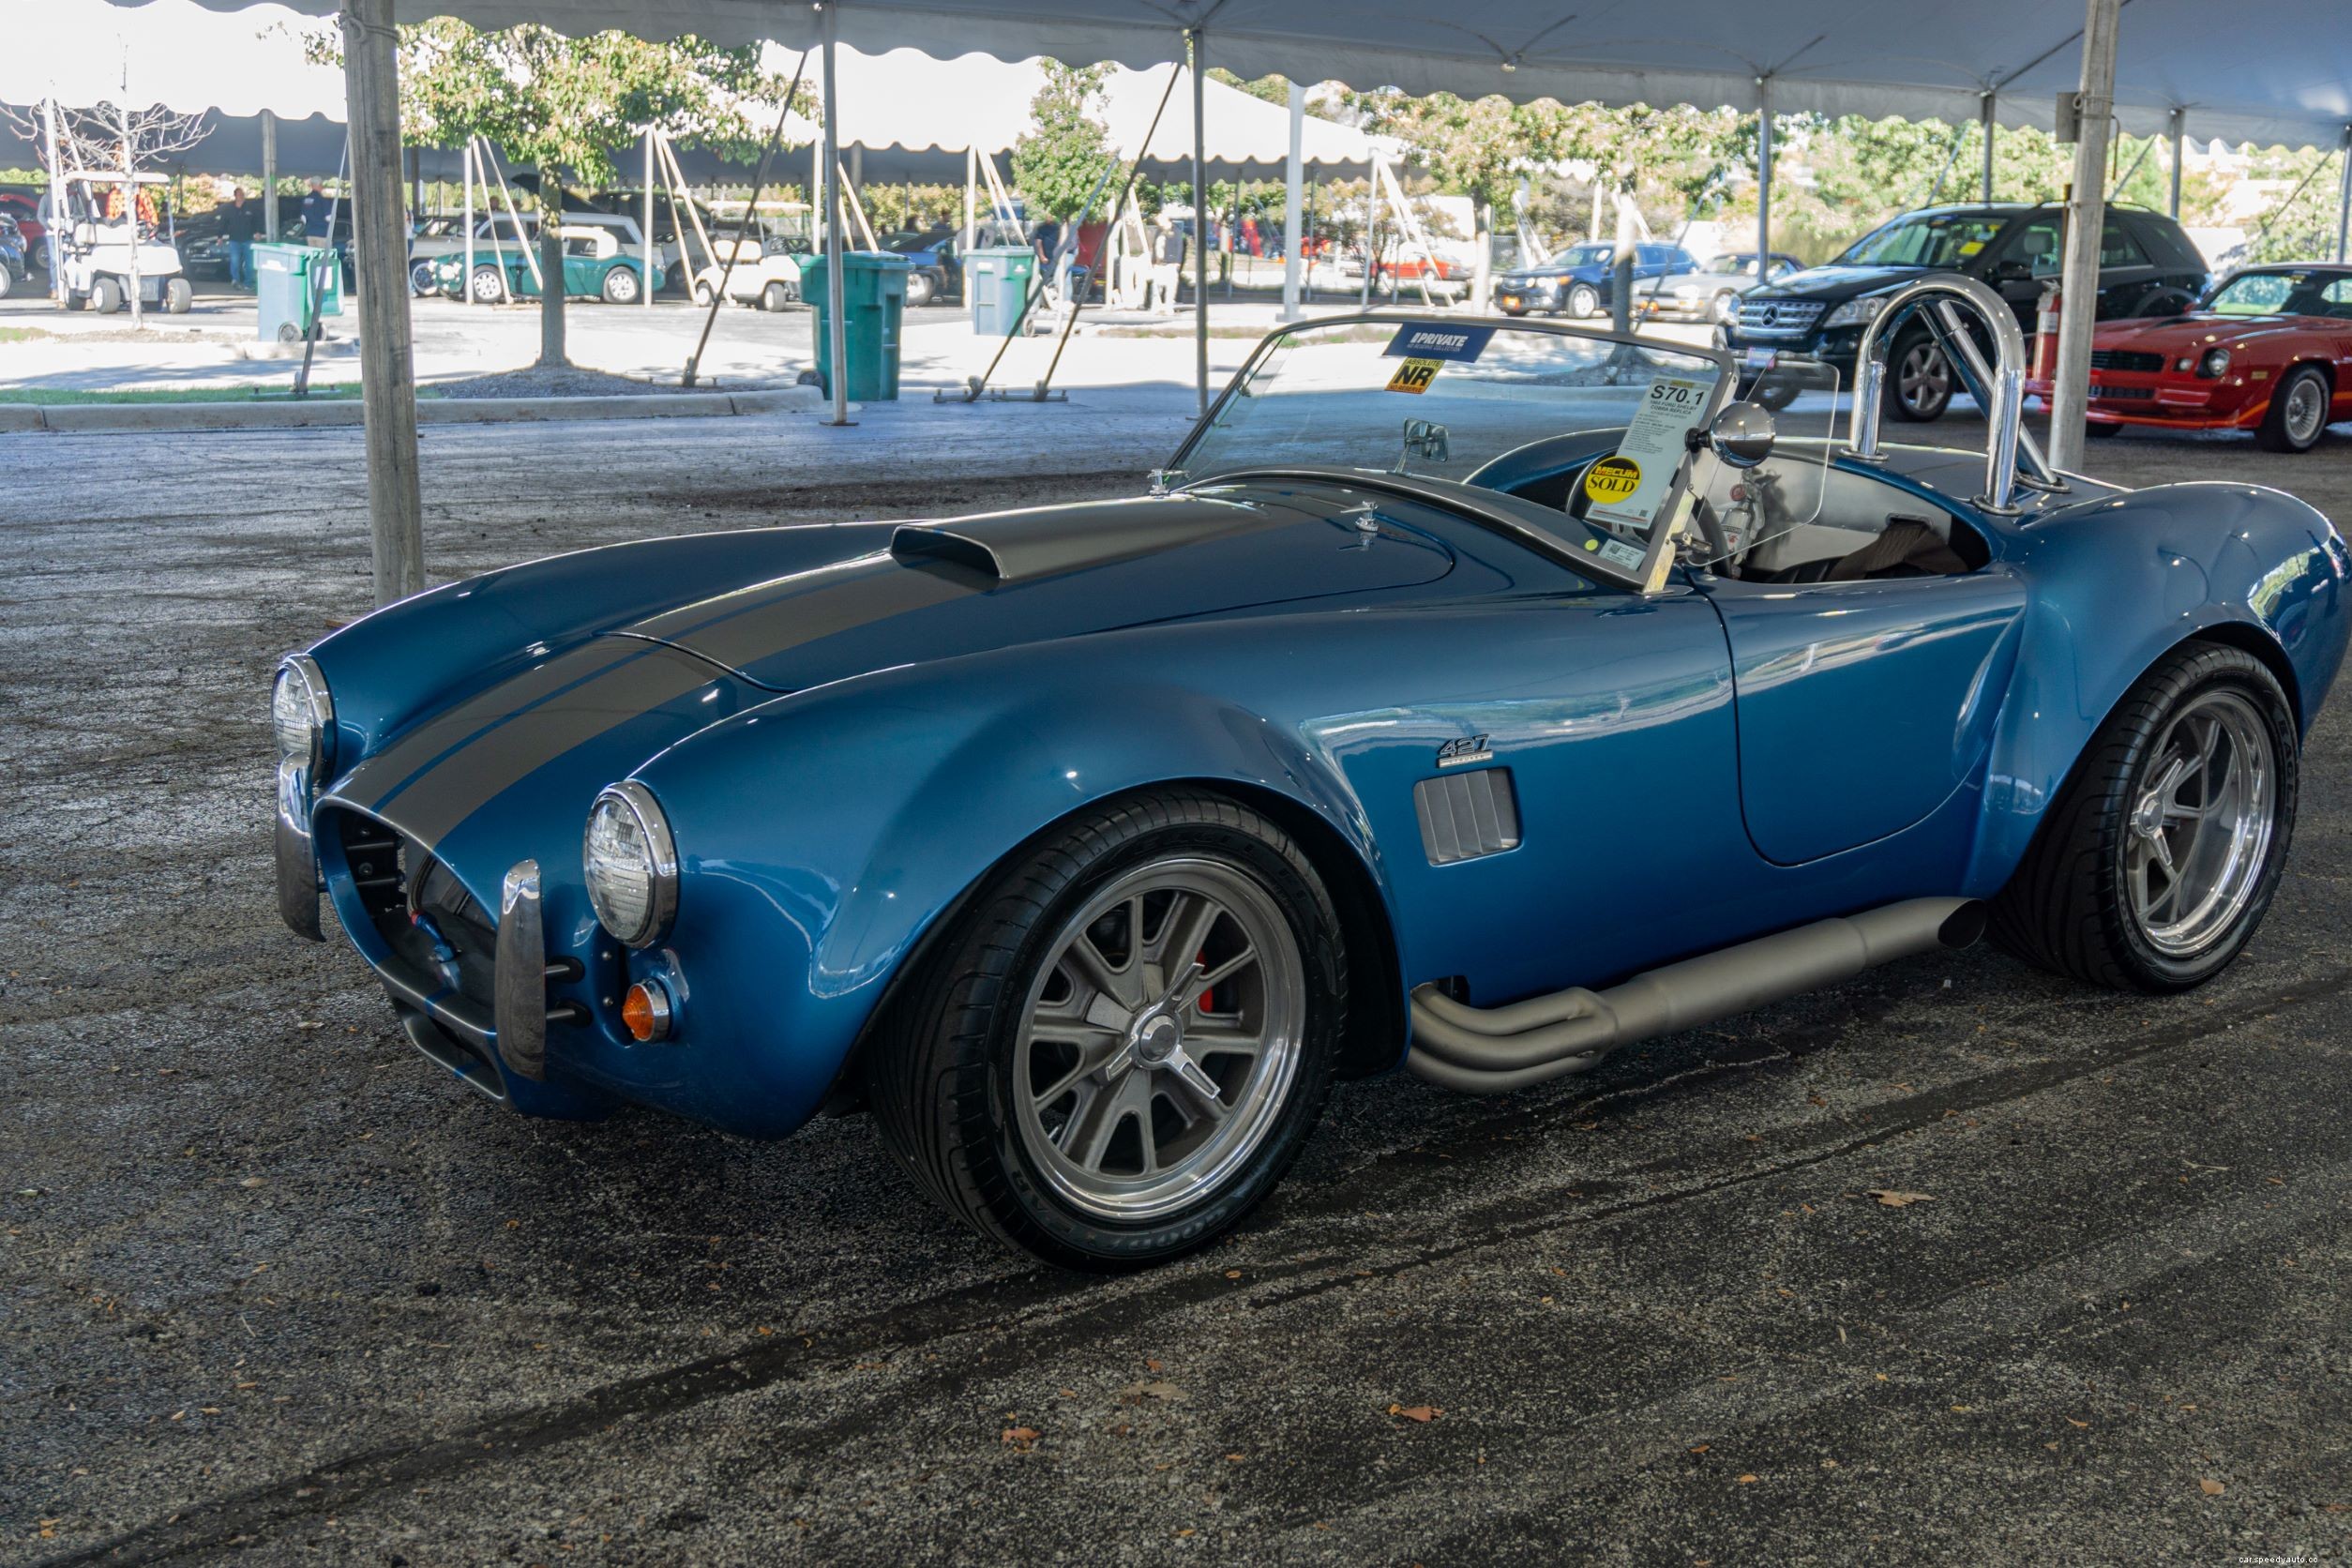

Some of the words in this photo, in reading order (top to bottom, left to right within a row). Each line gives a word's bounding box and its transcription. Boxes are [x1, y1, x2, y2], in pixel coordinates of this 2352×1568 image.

[1415, 332, 1469, 347] PRIVATE
[1407, 358, 1441, 367] ABSOLUTE
[1395, 365, 1435, 385] NR
[1651, 384, 1705, 405] S70.1
[1595, 465, 1638, 479] MECUM
[1588, 475, 1636, 493] SOLD
[1438, 733, 1491, 756] 427
